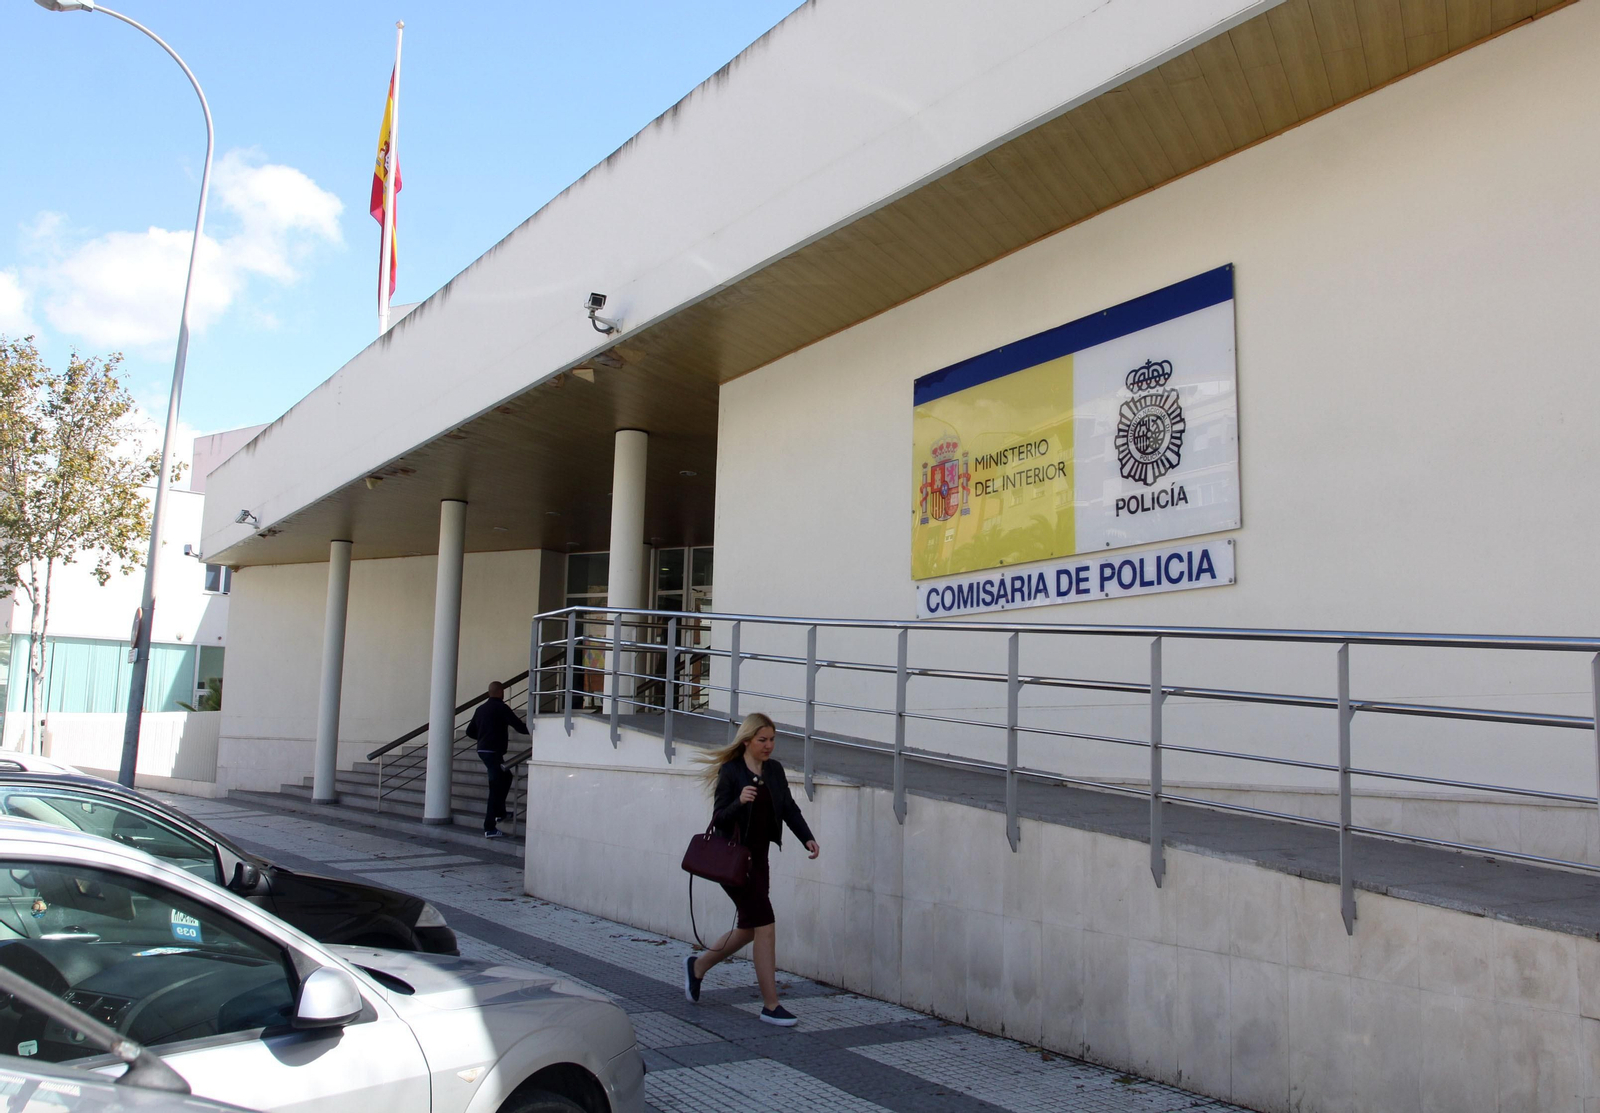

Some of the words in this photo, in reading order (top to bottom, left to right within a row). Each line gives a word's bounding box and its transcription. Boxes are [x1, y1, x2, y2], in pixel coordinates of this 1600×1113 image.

[974, 439, 1049, 472] MINISTERIO
[974, 478, 999, 497] DEL
[1002, 461, 1067, 491] INTERIOR
[1115, 482, 1189, 517] POLICÍA
[926, 572, 1050, 613] COMISARIA
[1056, 565, 1091, 597] DE
[1099, 549, 1217, 592] POLICIA
